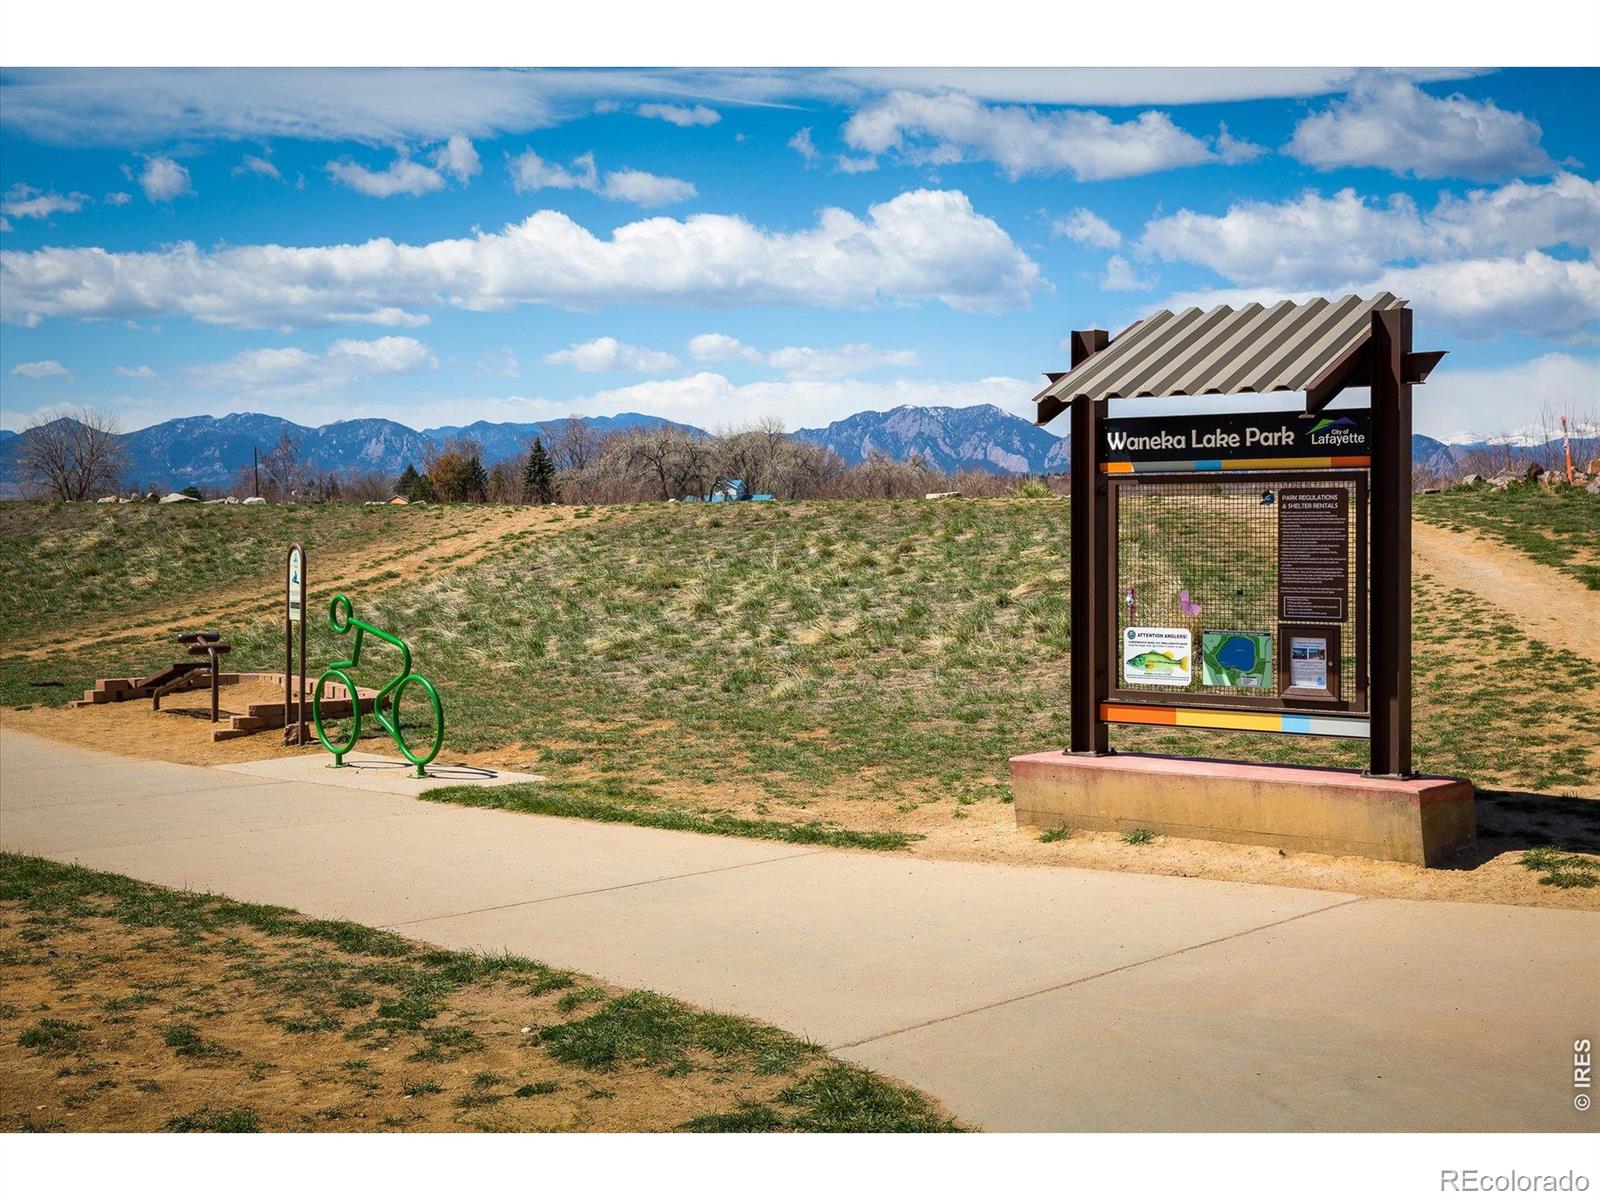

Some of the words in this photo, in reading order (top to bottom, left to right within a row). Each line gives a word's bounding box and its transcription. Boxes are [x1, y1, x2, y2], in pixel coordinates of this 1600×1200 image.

[1107, 430, 1186, 450] Waneka
[1191, 428, 1240, 448] Lake
[1245, 426, 1295, 447] Park
[1311, 433, 1365, 446] Lafayette
